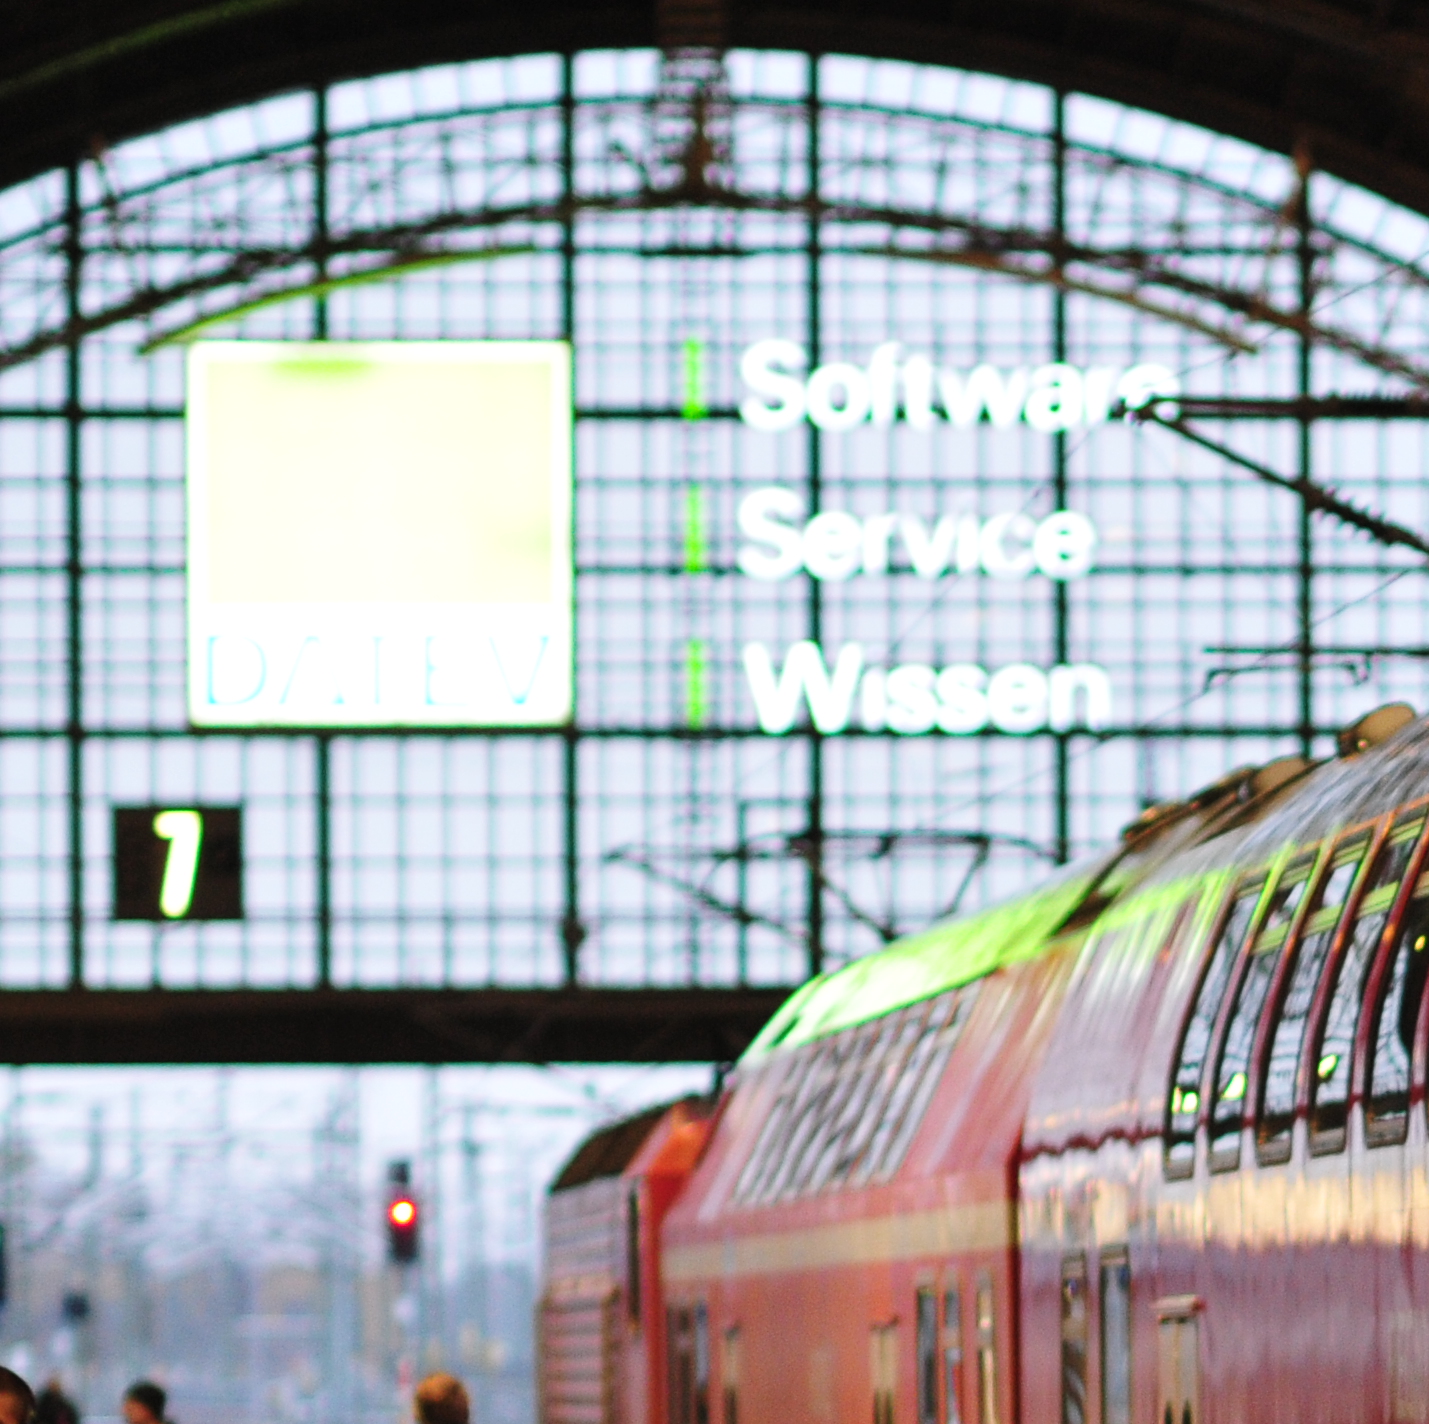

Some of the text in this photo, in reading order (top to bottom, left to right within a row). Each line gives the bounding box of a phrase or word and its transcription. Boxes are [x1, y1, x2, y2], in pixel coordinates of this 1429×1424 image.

[740, 339, 1180, 432] Software
[737, 486, 1095, 580] Service
[742, 640, 1112, 734] Wissen
